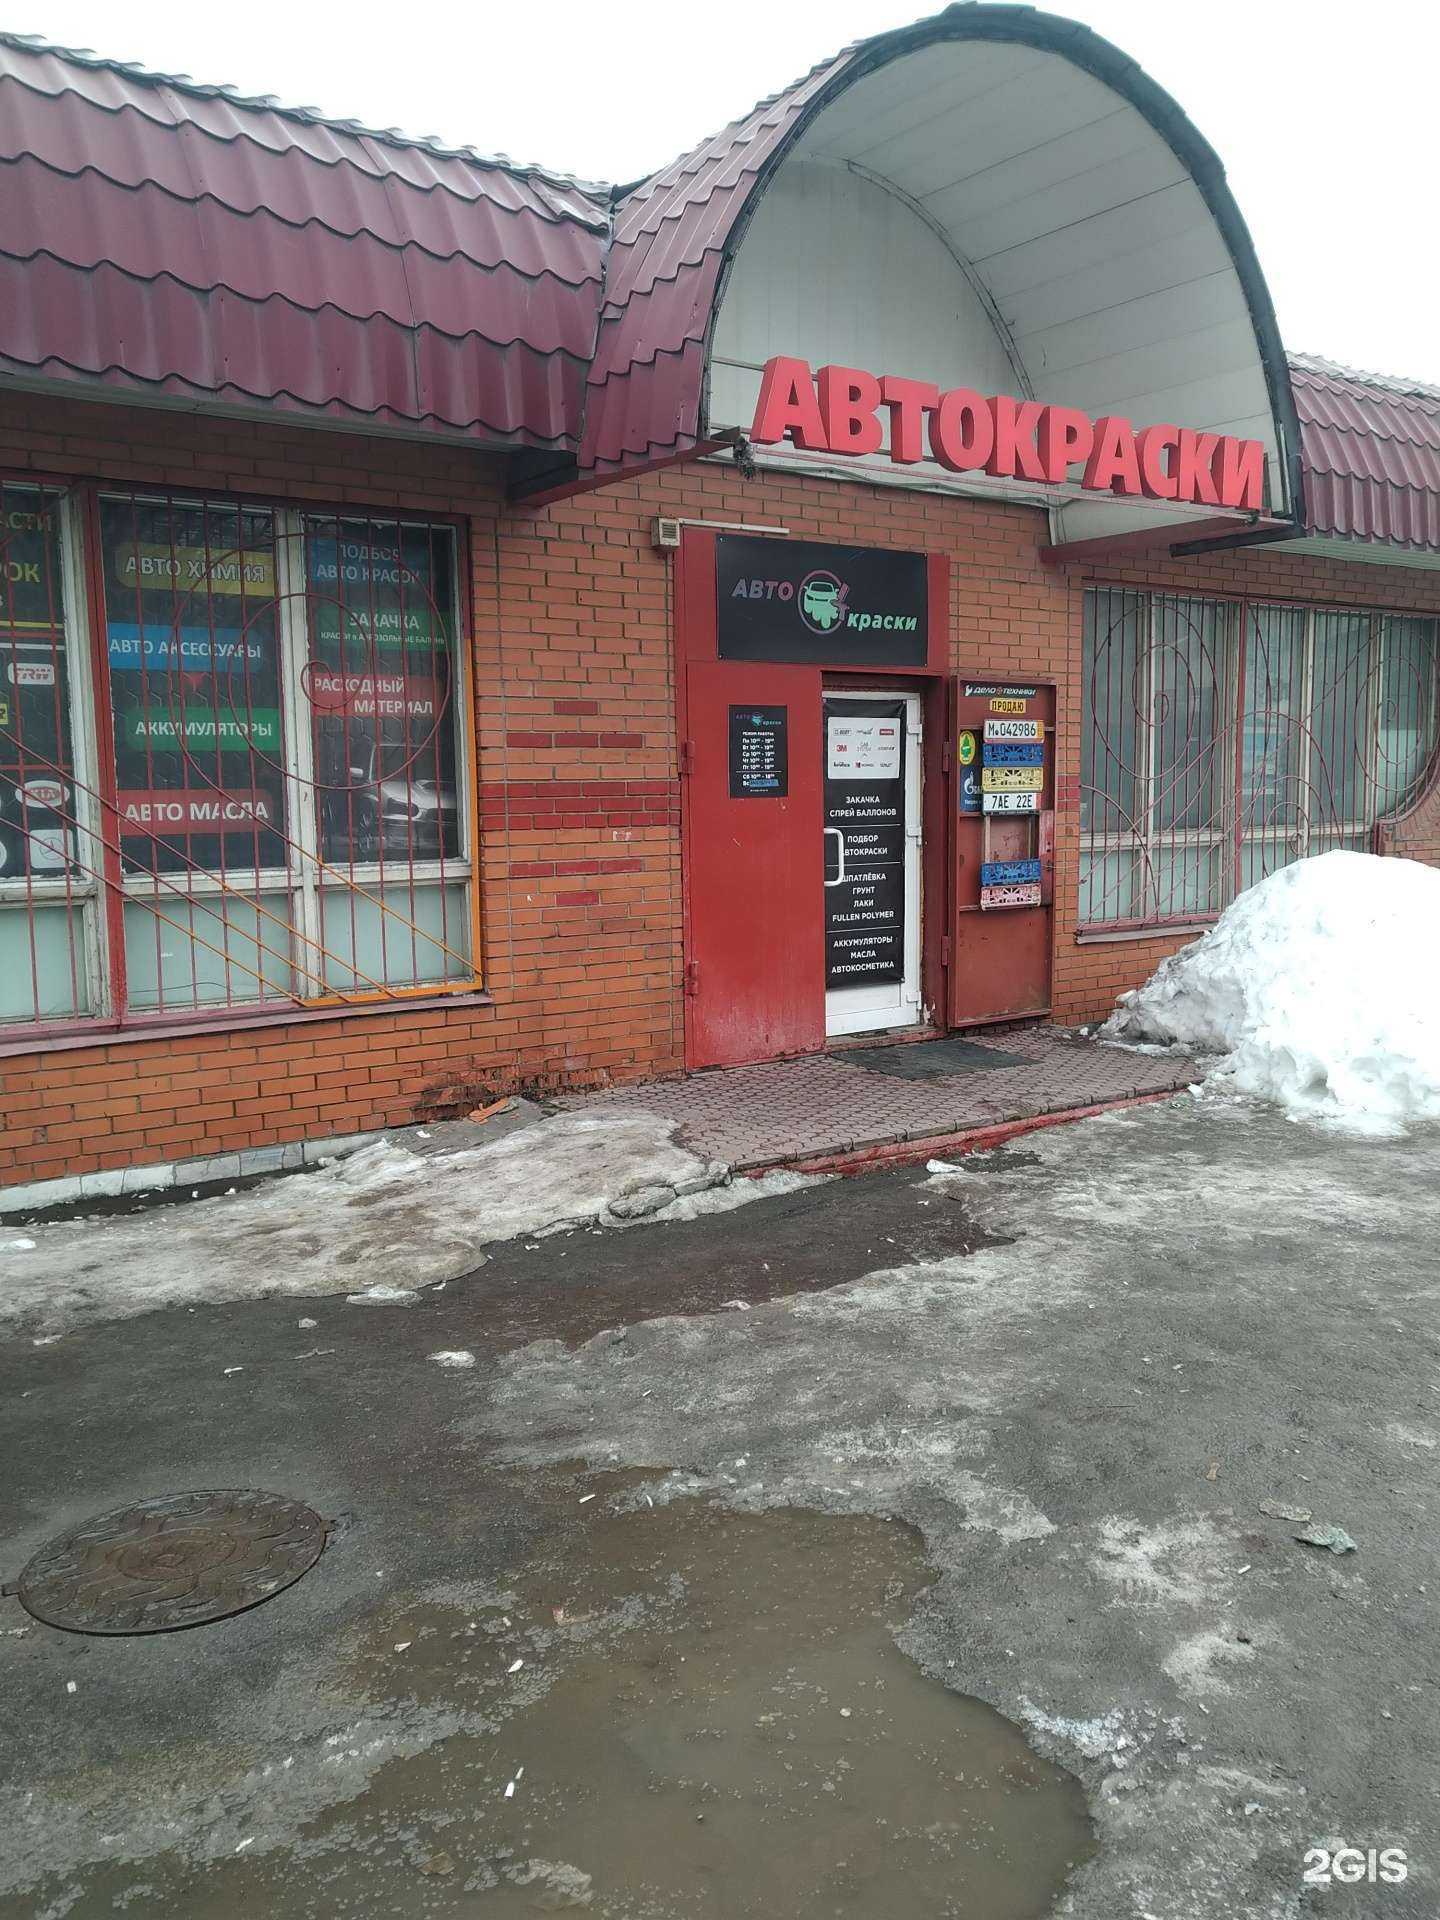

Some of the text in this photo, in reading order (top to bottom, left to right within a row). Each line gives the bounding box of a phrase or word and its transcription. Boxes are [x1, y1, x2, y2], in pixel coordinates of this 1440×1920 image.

[750, 355, 1265, 510] АВТОКРАСКИ
[0, 561, 40, 583] ОК
[126, 556, 265, 583] АВТО ХИМИЯ
[316, 564, 358, 580] АВТО
[731, 578, 794, 601] АВТО
[349, 612, 420, 630] ЗАКАЧКА
[847, 611, 918, 631] краски
[321, 631, 352, 642] КРАСИ
[110, 638, 261, 658] АВТО АКСЕССУАРЫ
[314, 676, 405, 695] РАСХОДНЫЙ
[353, 699, 433, 714] МАТЕРИАЛ
[991, 700, 1024, 712] ПРОДАЮ
[135, 721, 272, 737] АККУМУЛЯТОРЫ
[845, 795, 881, 804] ЗАКАЧКА
[125, 801, 269, 821] АВТО МАСЛА
[829, 807, 897, 818] СПРЕЙ БАЛЛОНОВ
[847, 834, 879, 844] ПОДБОР
[842, 847, 888, 856] ВТОКРАСКИ
[852, 886, 876, 895] ГРУНТ
[853, 899, 874, 908] ЛАКИ
[832, 910, 895, 922] FULLEN POLYMER
[833, 938, 893, 948] АККУМУЛЯТОРЫ
[850, 950, 876, 959] МАСЛА
[831, 960, 895, 974] АВТОКОСМЕТИКА
